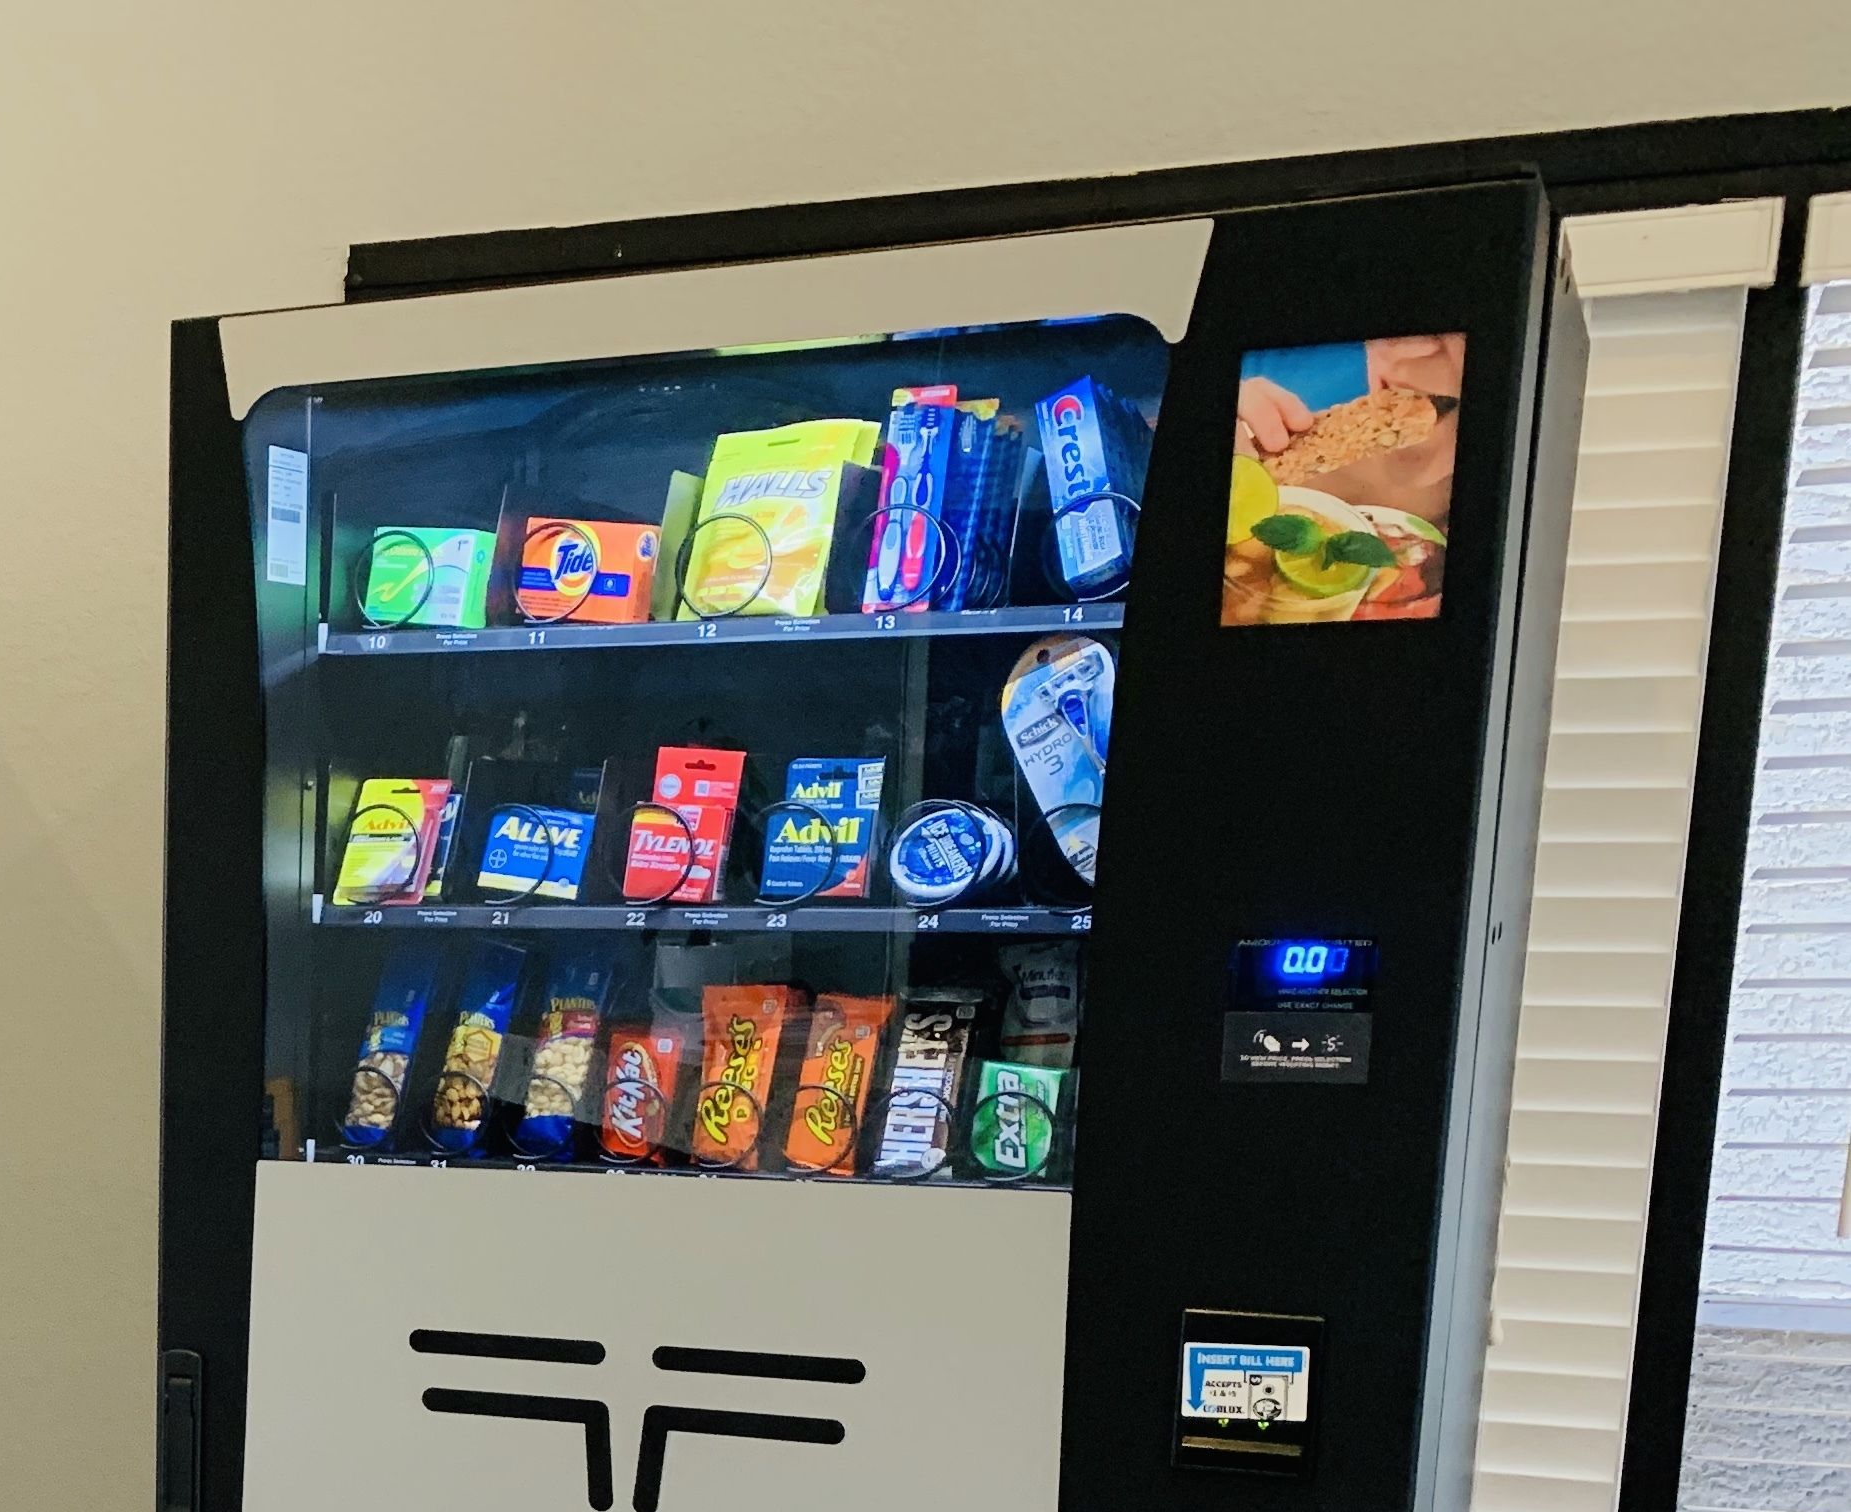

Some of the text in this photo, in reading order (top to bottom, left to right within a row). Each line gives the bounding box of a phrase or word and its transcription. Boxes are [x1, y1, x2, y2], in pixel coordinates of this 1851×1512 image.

[1052, 395, 1094, 499] Crest
[714, 471, 834, 511] HALLS
[555, 544, 594, 581] Tide
[875, 616, 896, 629] 13
[1062, 608, 1083, 622] 14
[529, 631, 545, 644] 11
[698, 624, 717, 637] 12
[369, 636, 386, 649] 10
[1019, 716, 1060, 744] Schick
[1023, 732, 1072, 767] HYDRO
[1043, 754, 1065, 776] 3
[790, 782, 844, 798] Advil
[363, 817, 416, 833] Advi
[774, 817, 861, 844] Advil
[633, 830, 716, 856] TYLENOL
[364, 911, 383, 924] 20
[492, 912, 510, 925] 21
[626, 913, 645, 926] 22
[767, 914, 787, 927] 23
[917, 915, 939, 929] 24
[1071, 915, 1092, 930] 25
[701, 1015, 755, 1144] Reese's
[805, 1037, 853, 1146] Reese's
[347, 1155, 364, 1166] 30
[1197, 1352, 1295, 1367] INSERT BILL HERE
[1205, 1380, 1242, 1388] ACCEPTS
